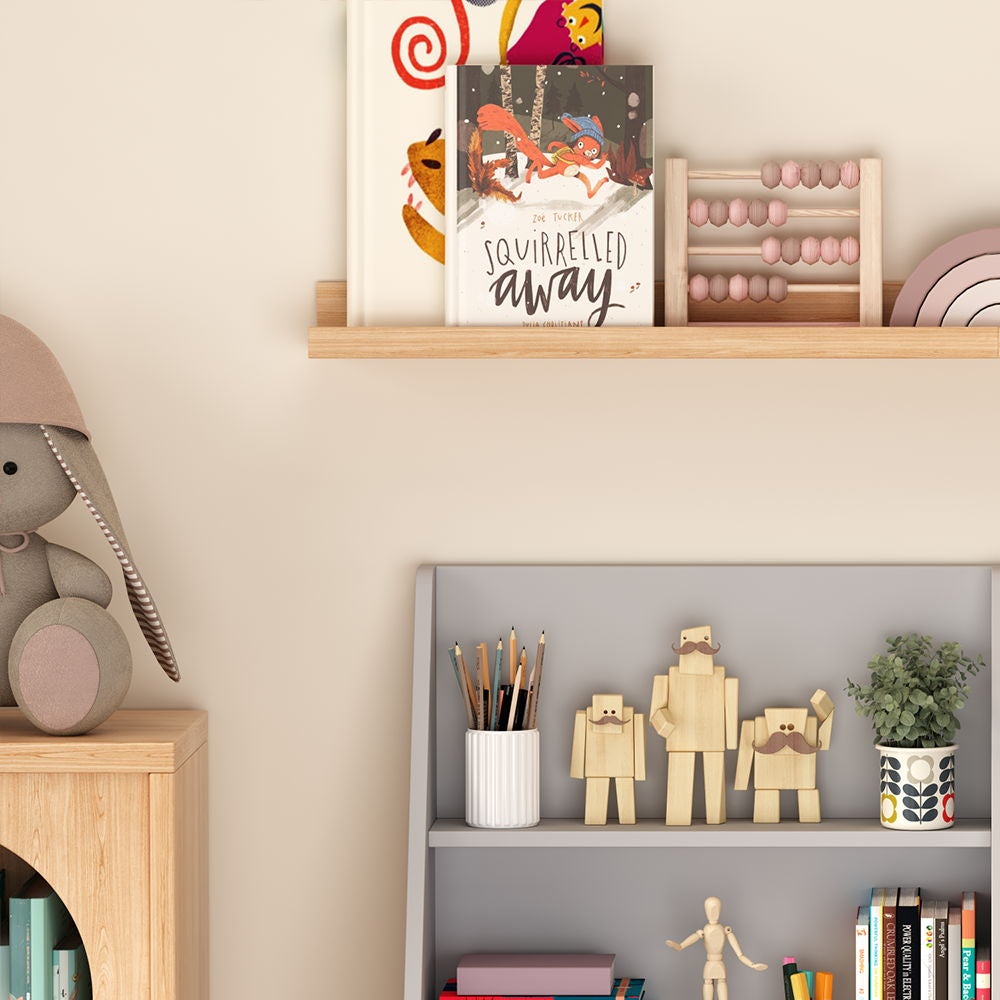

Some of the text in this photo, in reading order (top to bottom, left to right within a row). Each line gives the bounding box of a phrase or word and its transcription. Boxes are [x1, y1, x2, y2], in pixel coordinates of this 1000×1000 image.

[488, 266, 626, 327] away
[886, 922, 896, 969] CRUMBLED
[902, 924, 912, 944] POWER
[901, 945, 912, 971] QUALITY
[962, 949, 971, 971] Pear
[886, 970, 896, 990] OAK
